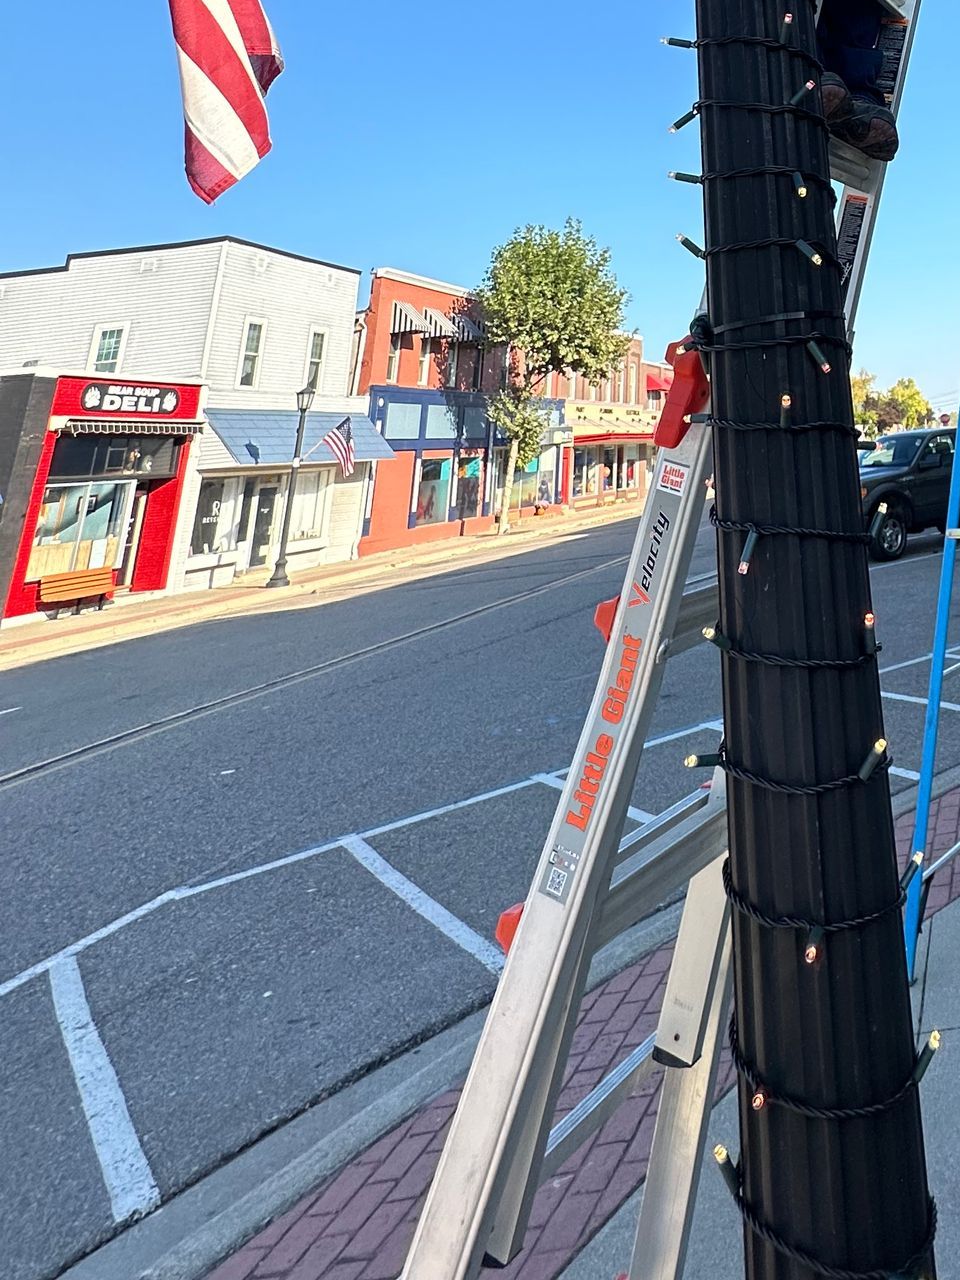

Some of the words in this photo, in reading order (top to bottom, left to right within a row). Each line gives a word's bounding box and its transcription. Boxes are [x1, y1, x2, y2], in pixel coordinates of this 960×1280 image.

[101, 394, 161, 413] DELI
[663, 464, 686, 480] Little
[660, 474, 684, 490] Giant
[626, 511, 671, 609] Velocity
[565, 732, 614, 833] Little
[601, 633, 643, 726] Giant
